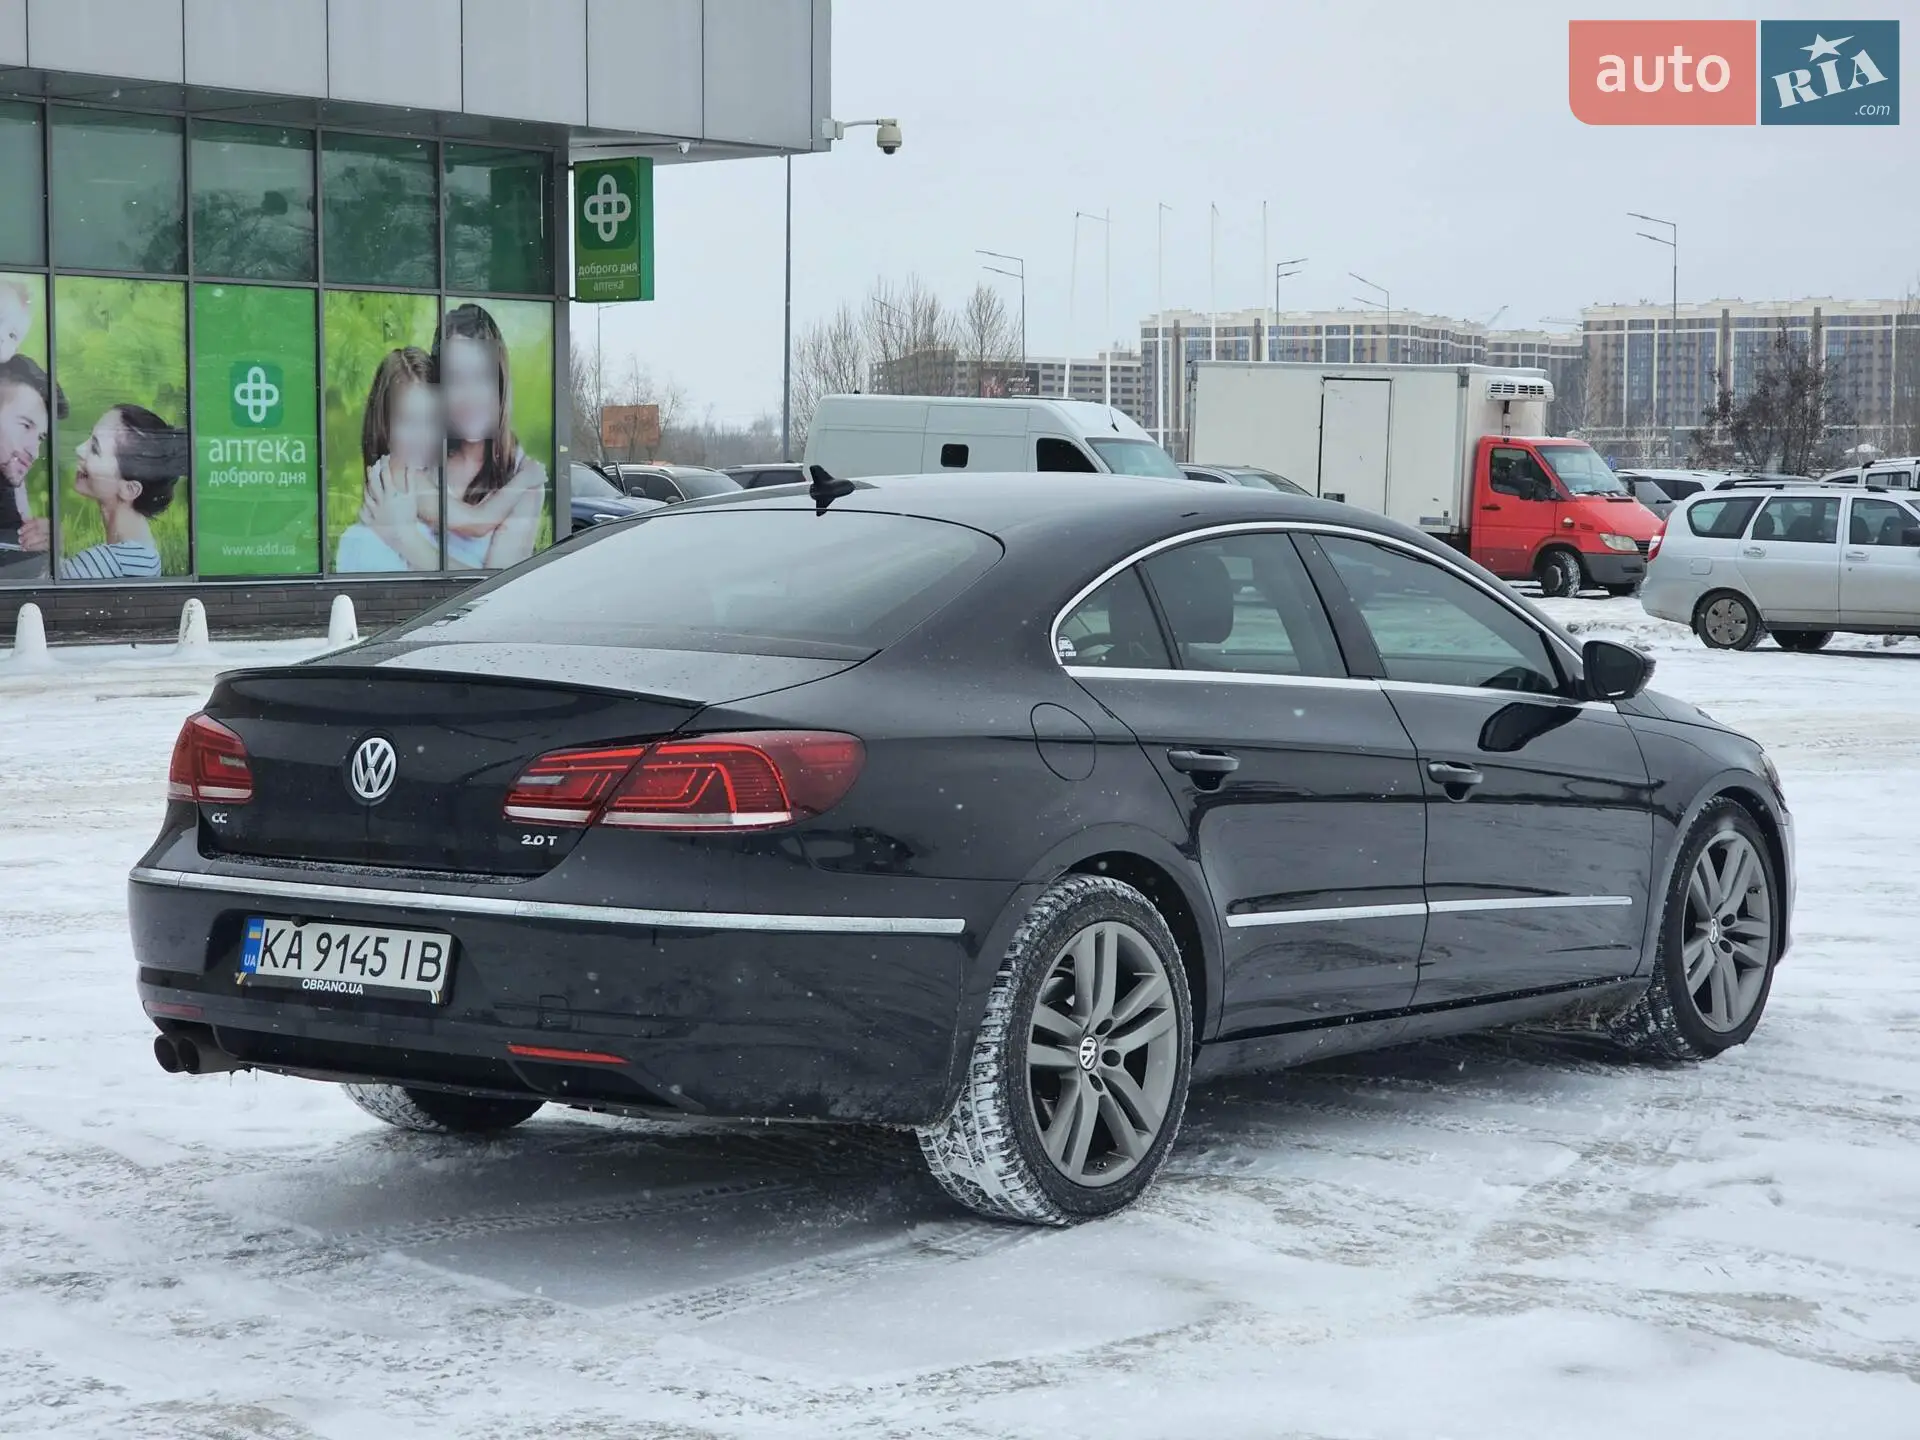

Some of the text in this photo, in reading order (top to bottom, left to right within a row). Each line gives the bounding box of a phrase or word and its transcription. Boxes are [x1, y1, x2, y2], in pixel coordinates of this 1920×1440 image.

[578, 262, 637, 277] доброго дня
[208, 438, 305, 464] аптека
[209, 466, 306, 487] доброго дня
[222, 542, 296, 557] www.add.ua
[244, 954, 257, 968] UA
[260, 928, 442, 983] KA 9145 IB
[302, 979, 364, 995] OBRANO.UA
